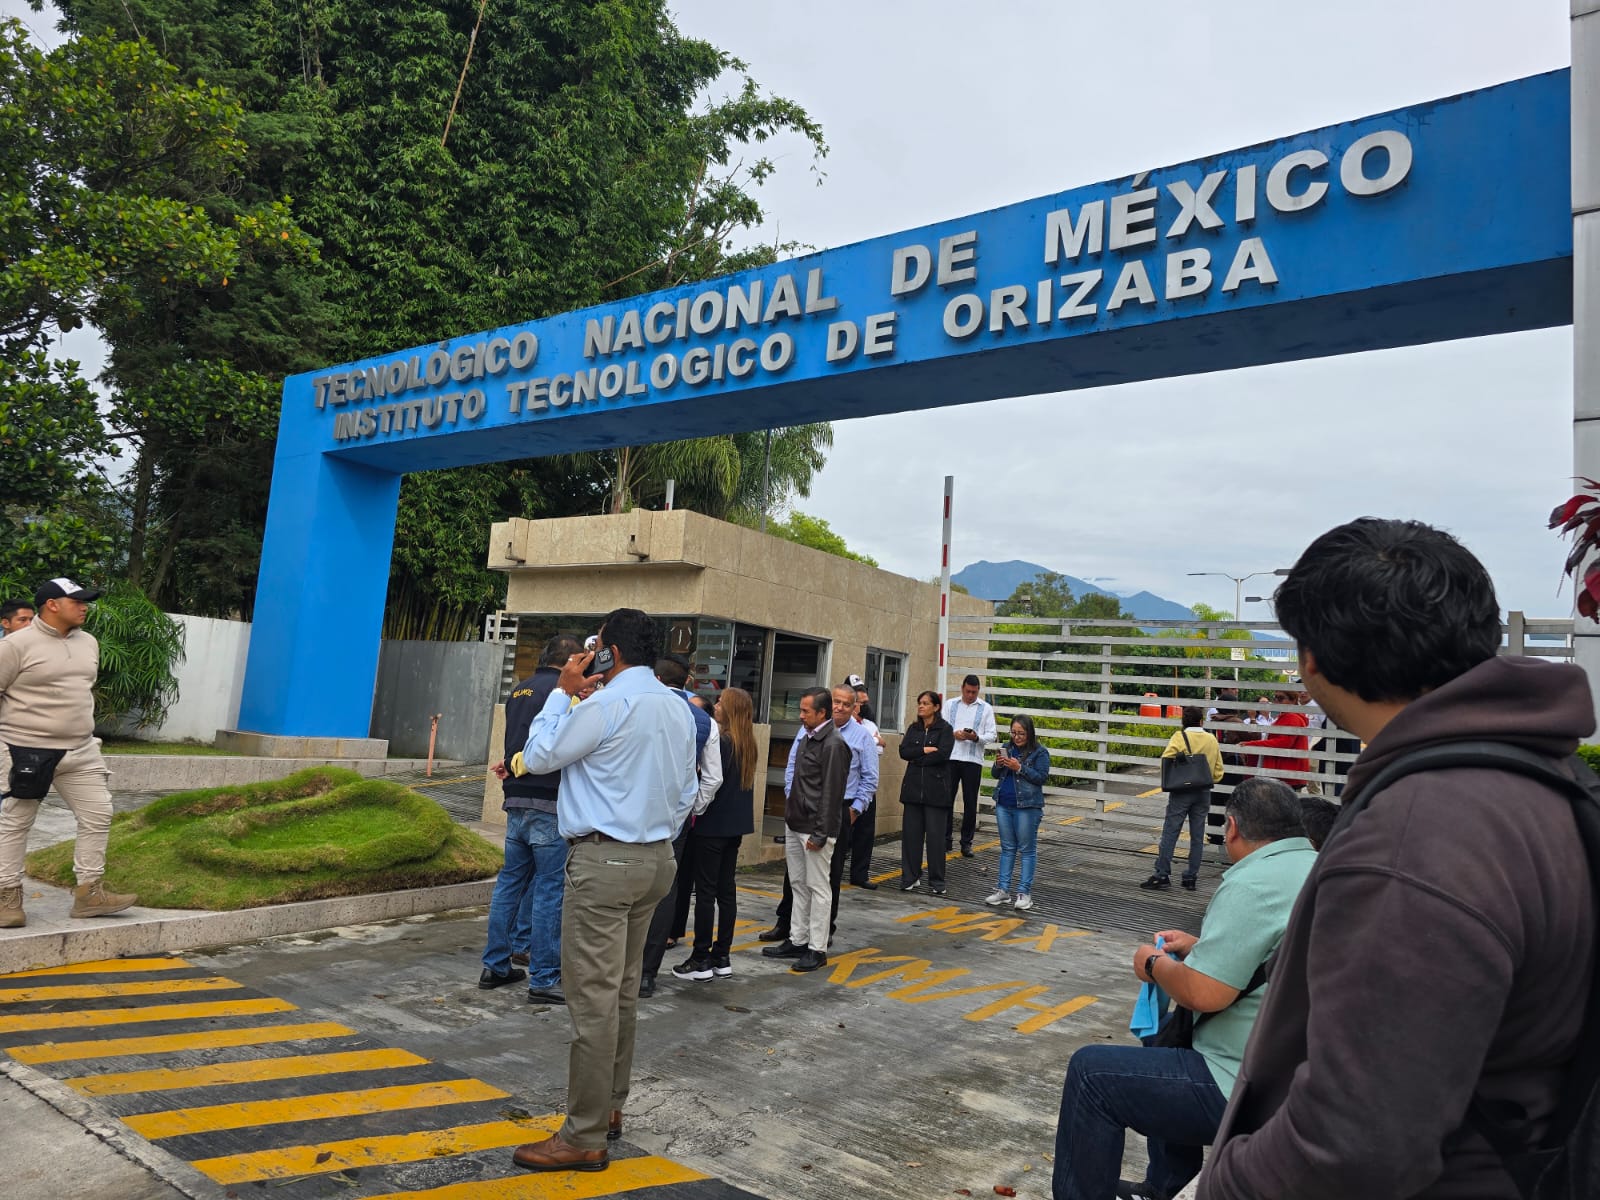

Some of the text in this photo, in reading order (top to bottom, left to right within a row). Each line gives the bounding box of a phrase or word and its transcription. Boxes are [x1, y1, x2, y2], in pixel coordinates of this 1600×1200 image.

[313, 130, 1413, 408] TECNOLÓGICO NACIONAL DE MÉXICO
[333, 236, 1279, 440] INSTITUTO TECNOLOGICO DE ORIZABA
[896, 906, 1092, 952] MAX
